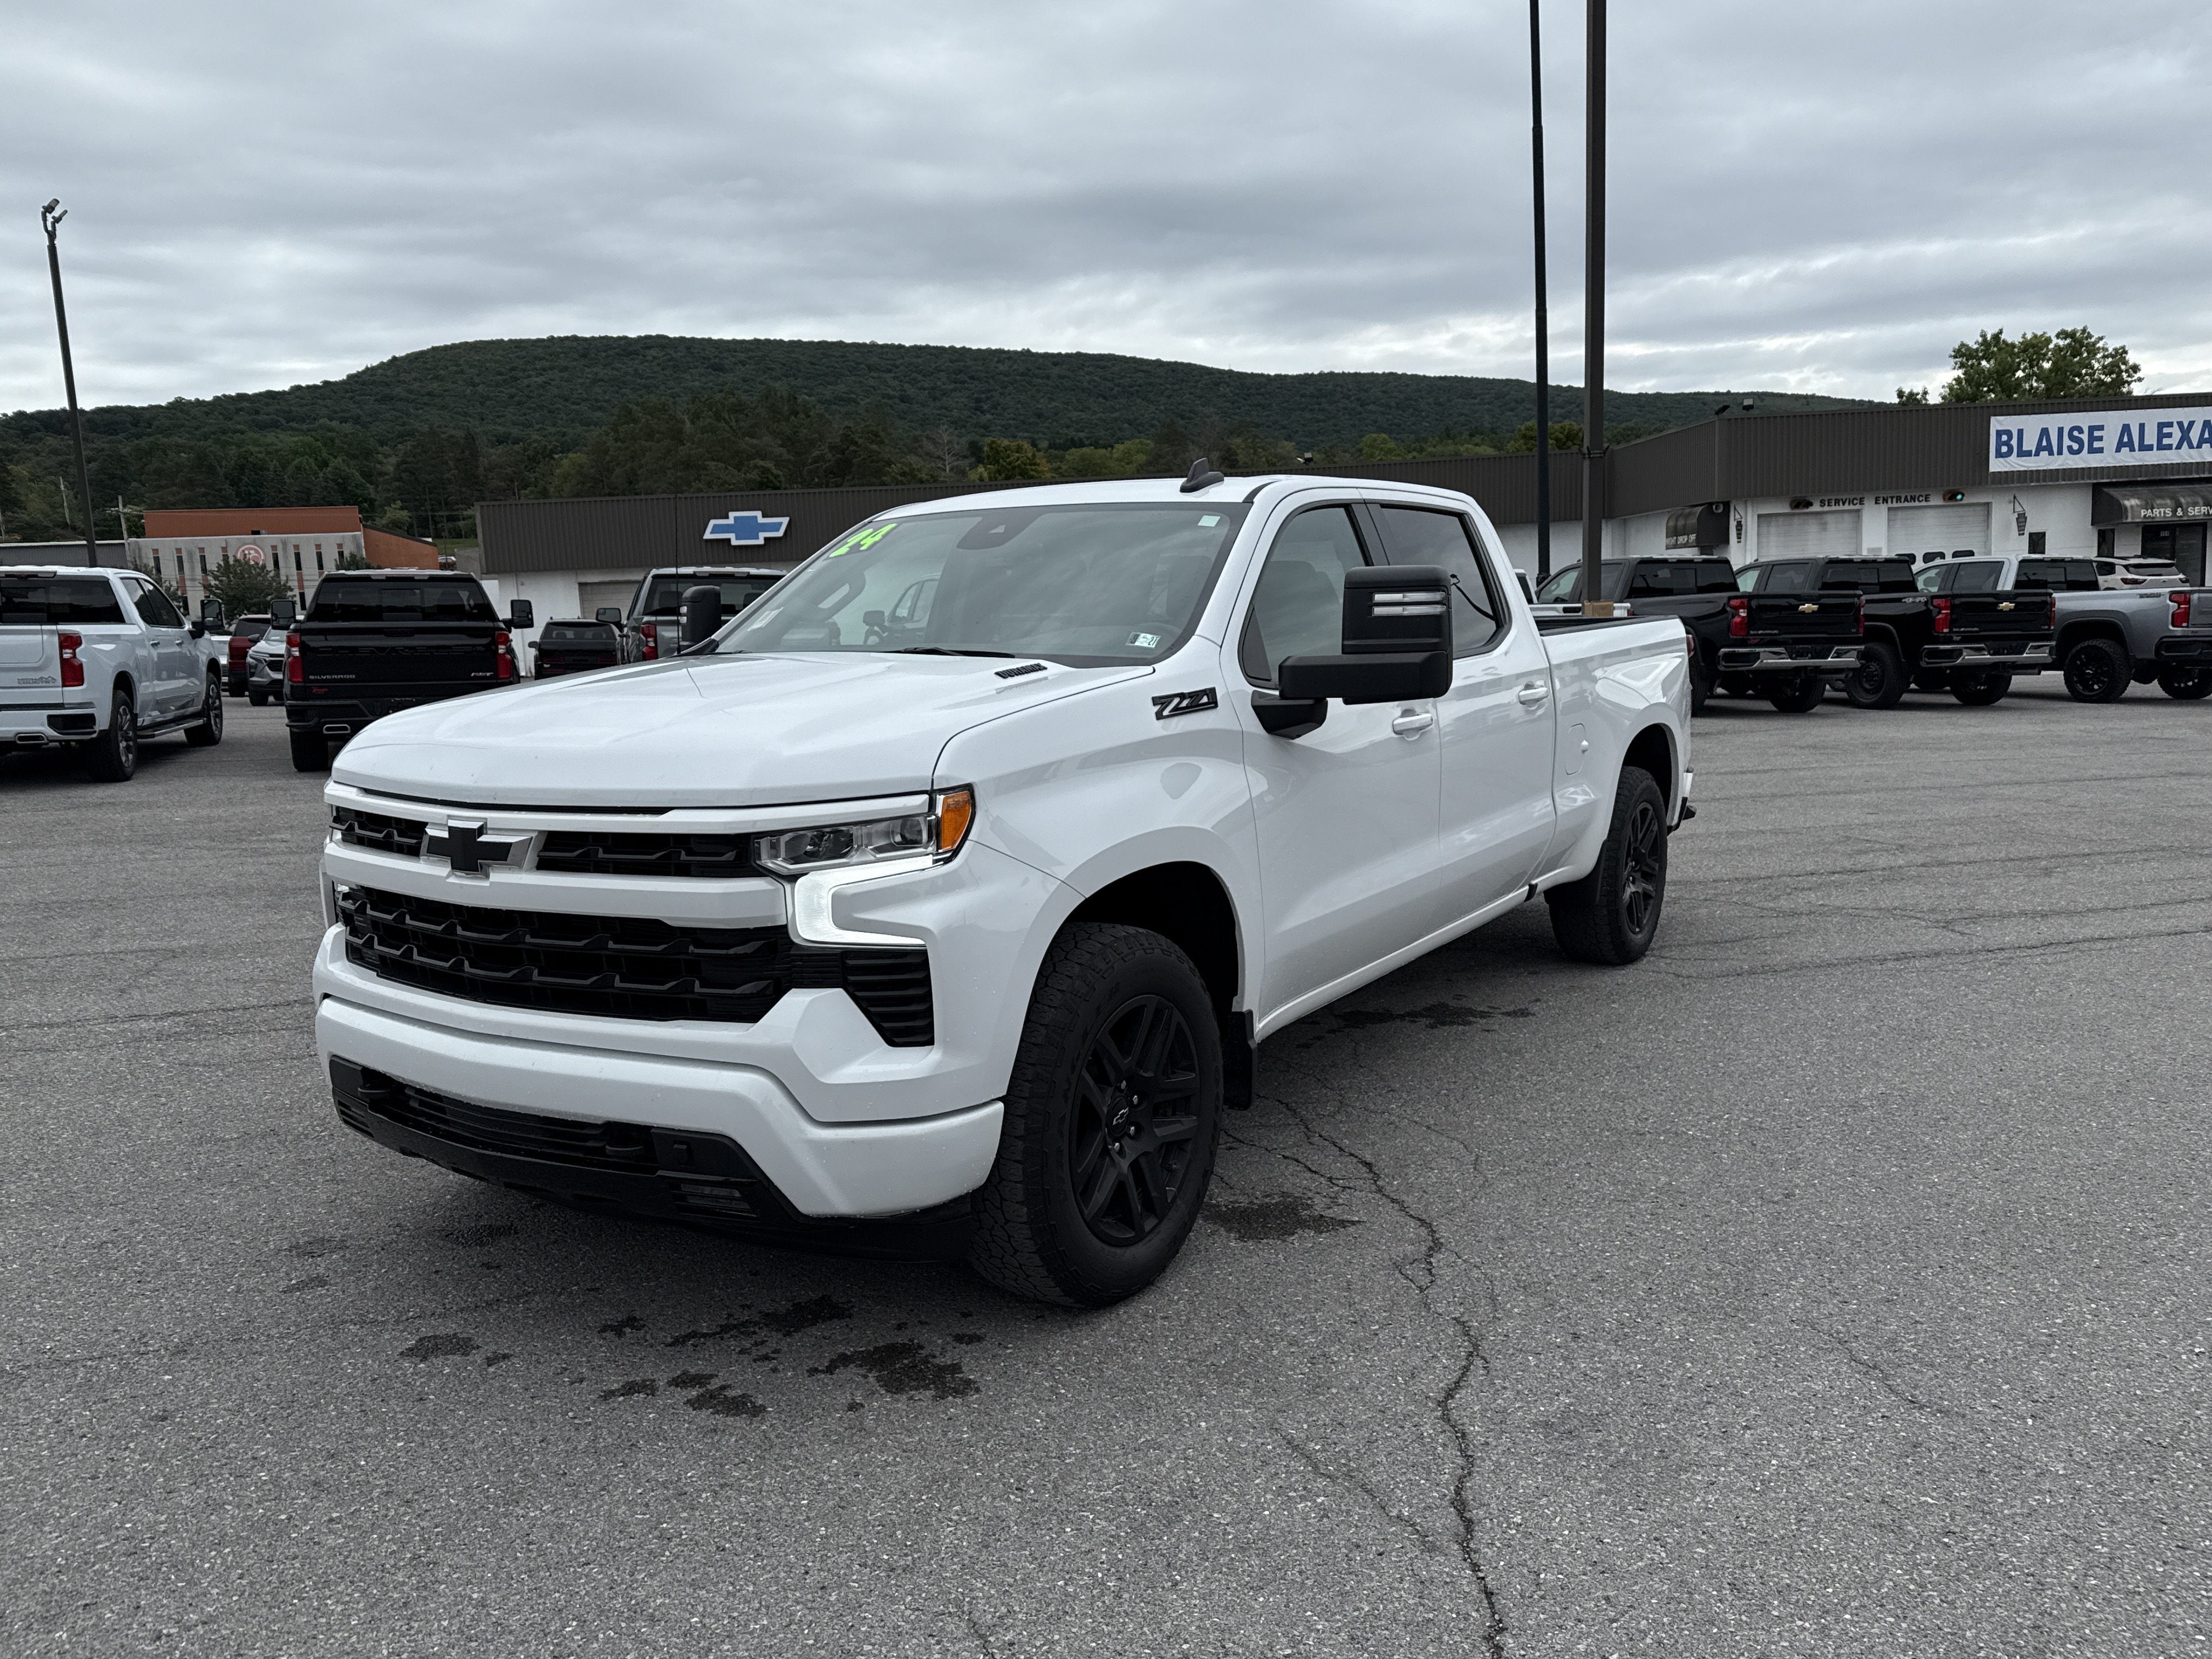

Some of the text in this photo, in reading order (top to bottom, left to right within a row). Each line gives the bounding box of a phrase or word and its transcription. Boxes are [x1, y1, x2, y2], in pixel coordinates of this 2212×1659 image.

[1995, 420, 2212, 459] BLAISE ALEXA
[1820, 494, 1931, 507] SERVICE ENTRANCE
[2141, 508, 2172, 517] PARTS
[2176, 507, 2183, 516] &
[828, 523, 898, 557] 24
[994, 662, 1048, 679] DURAMAX
[1151, 686, 1218, 720] Z71
